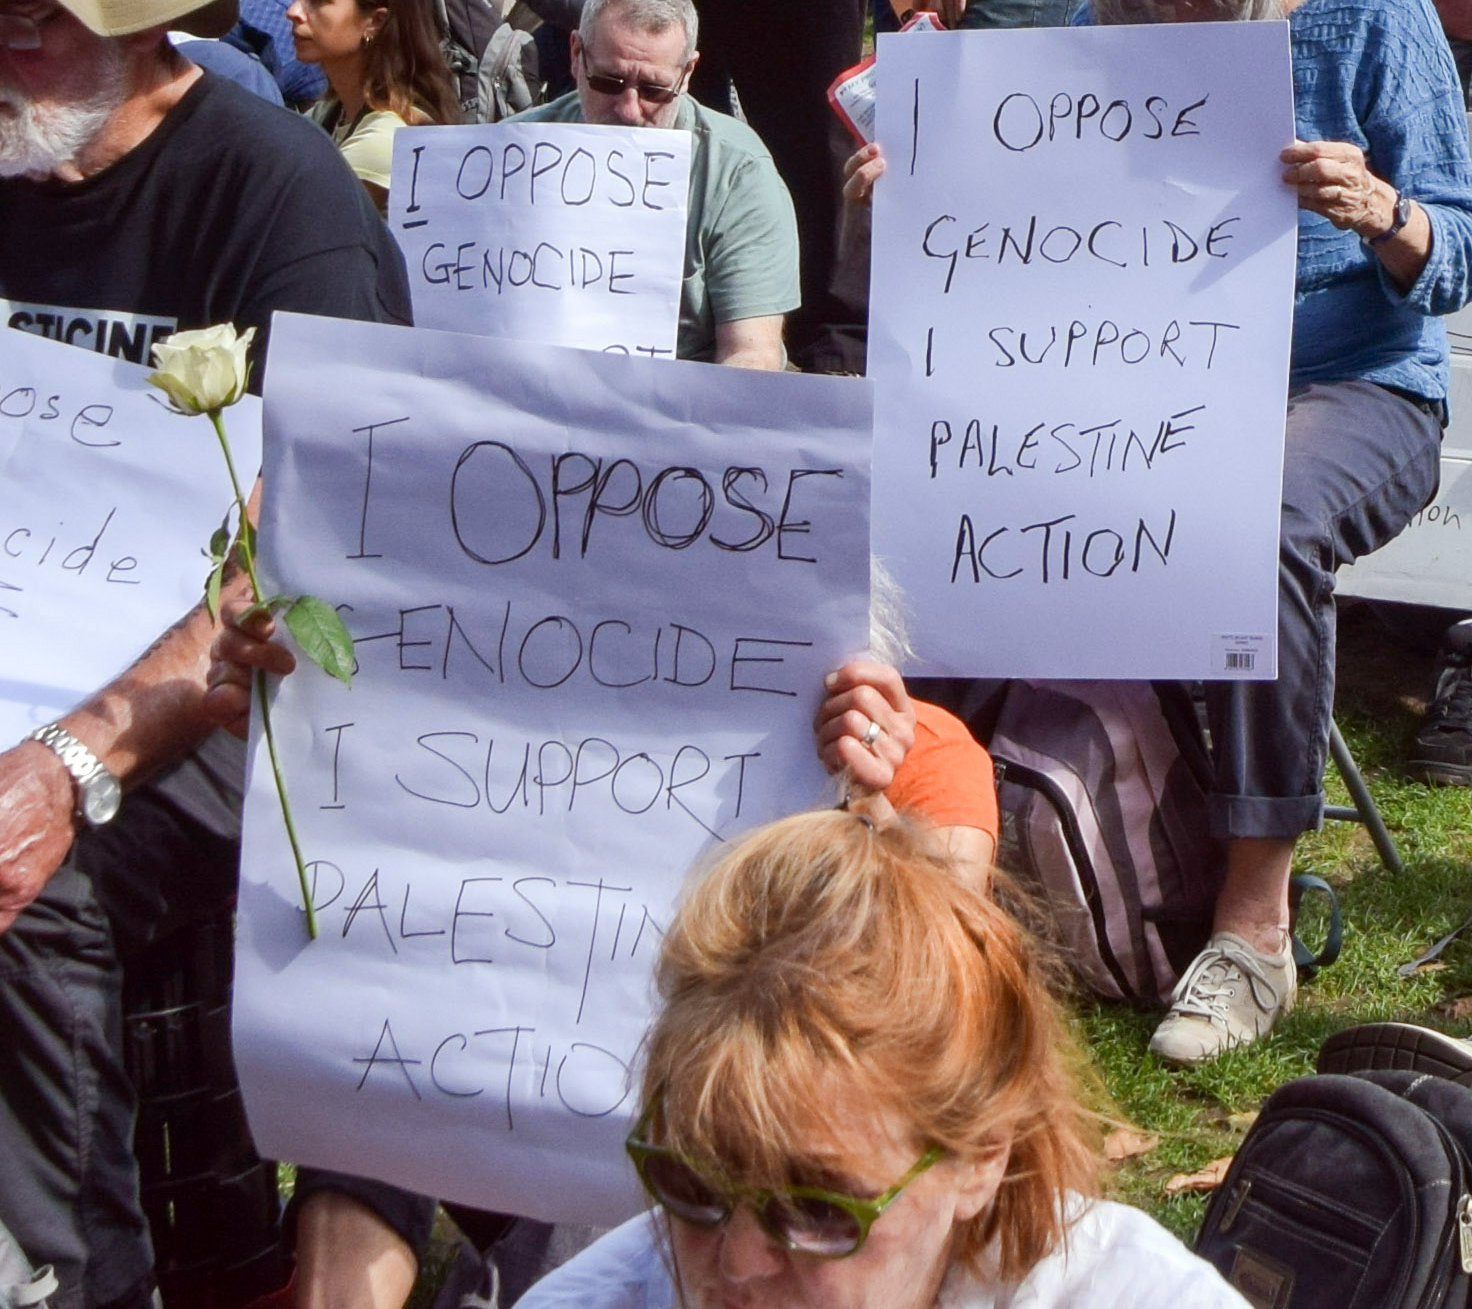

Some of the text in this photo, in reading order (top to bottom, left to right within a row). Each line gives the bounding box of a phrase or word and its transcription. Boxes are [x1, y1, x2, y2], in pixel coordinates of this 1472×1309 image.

[910, 77, 1210, 176] I OPPOSE
[405, 141, 676, 213] I OPPOSE
[422, 241, 639, 296] GENOCIDE
[922, 214, 1242, 294] GENOCIDE
[926, 319, 1241, 378] I SUPPORT
[930, 404, 1207, 479] PALESTINE
[346, 416, 844, 564] I OPPOSE
[950, 508, 1176, 585] ACTION
[319, 722, 762, 842] I SUPPORT
[353, 1018, 631, 1131] ACTIO
